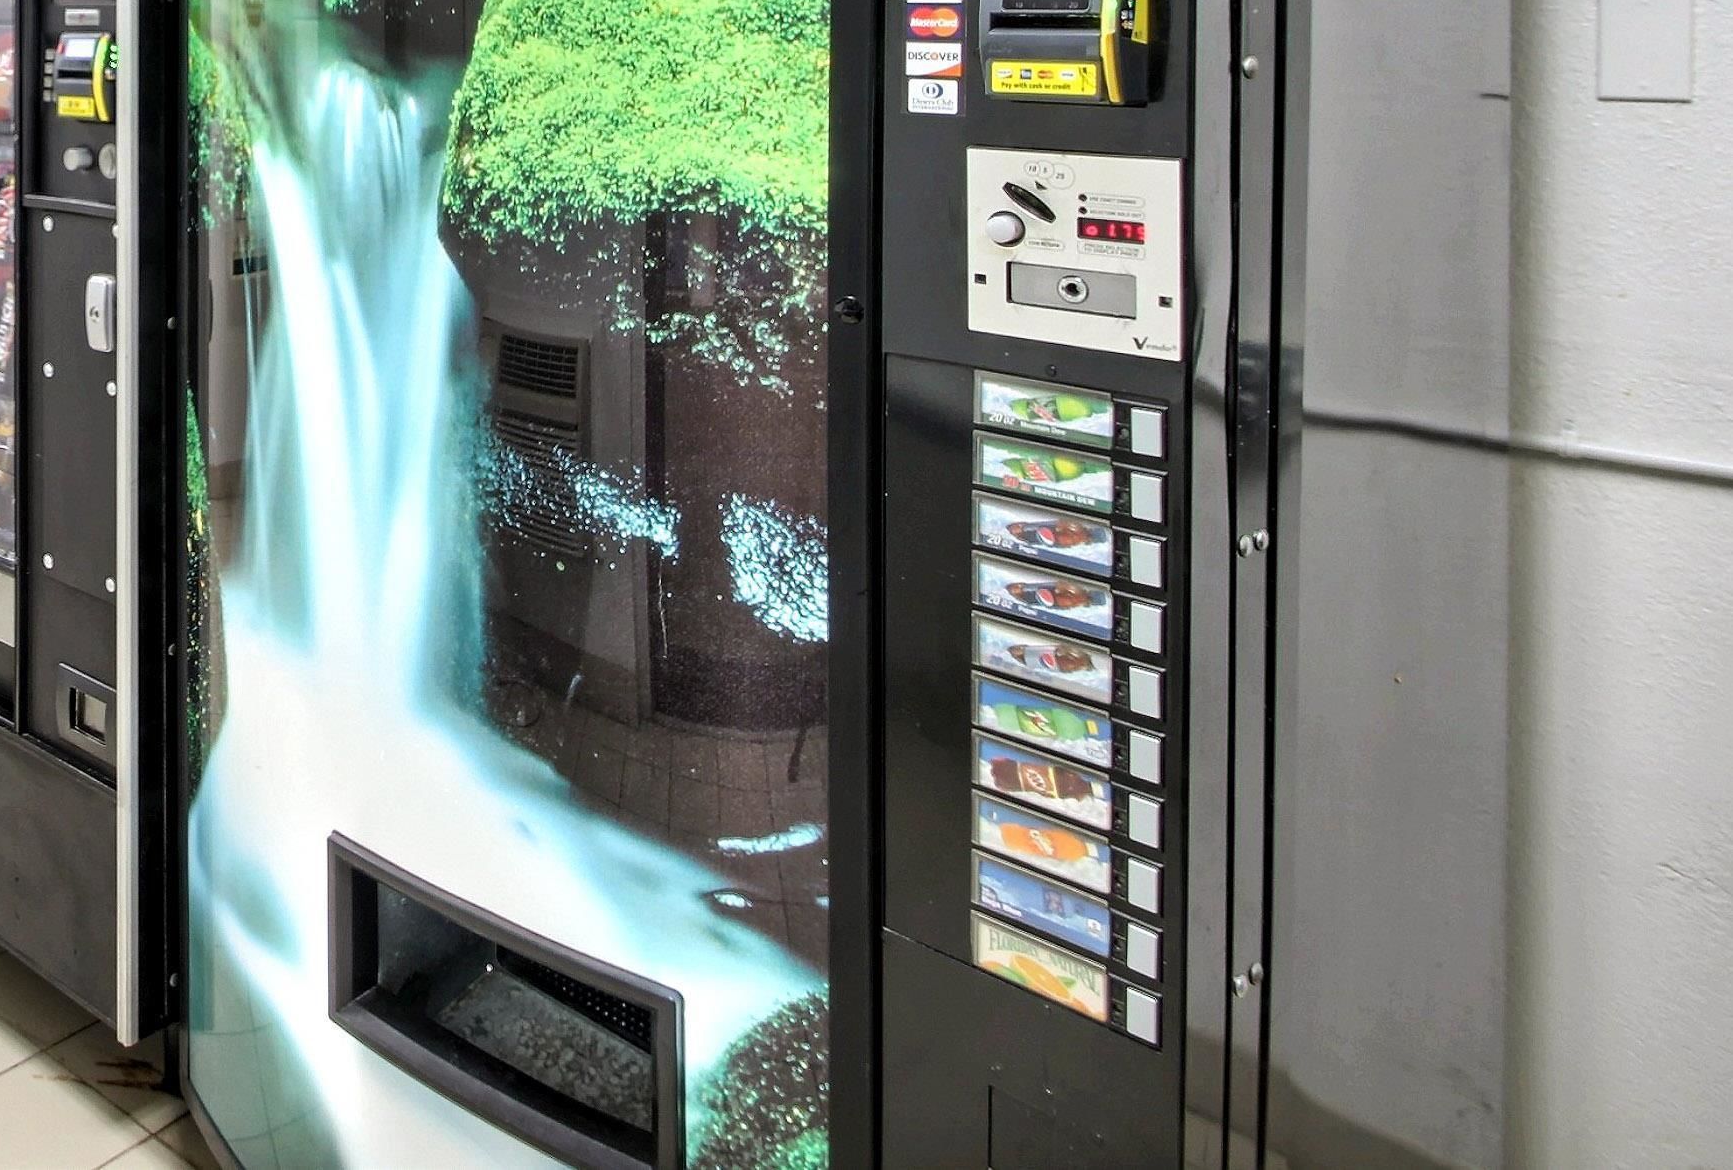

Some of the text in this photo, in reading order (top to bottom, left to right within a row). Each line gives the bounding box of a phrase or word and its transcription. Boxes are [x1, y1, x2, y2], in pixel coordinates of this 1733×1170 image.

[910, 18, 958, 28] MasterCard
[908, 51, 959, 62] DISCOVER
[1001, 82, 1012, 90] Pay
[989, 413, 1002, 422] 20
[1034, 487, 1075, 501] MOUNTAIN
[986, 534, 1001, 545] 20
[986, 594, 1000, 605] 20
